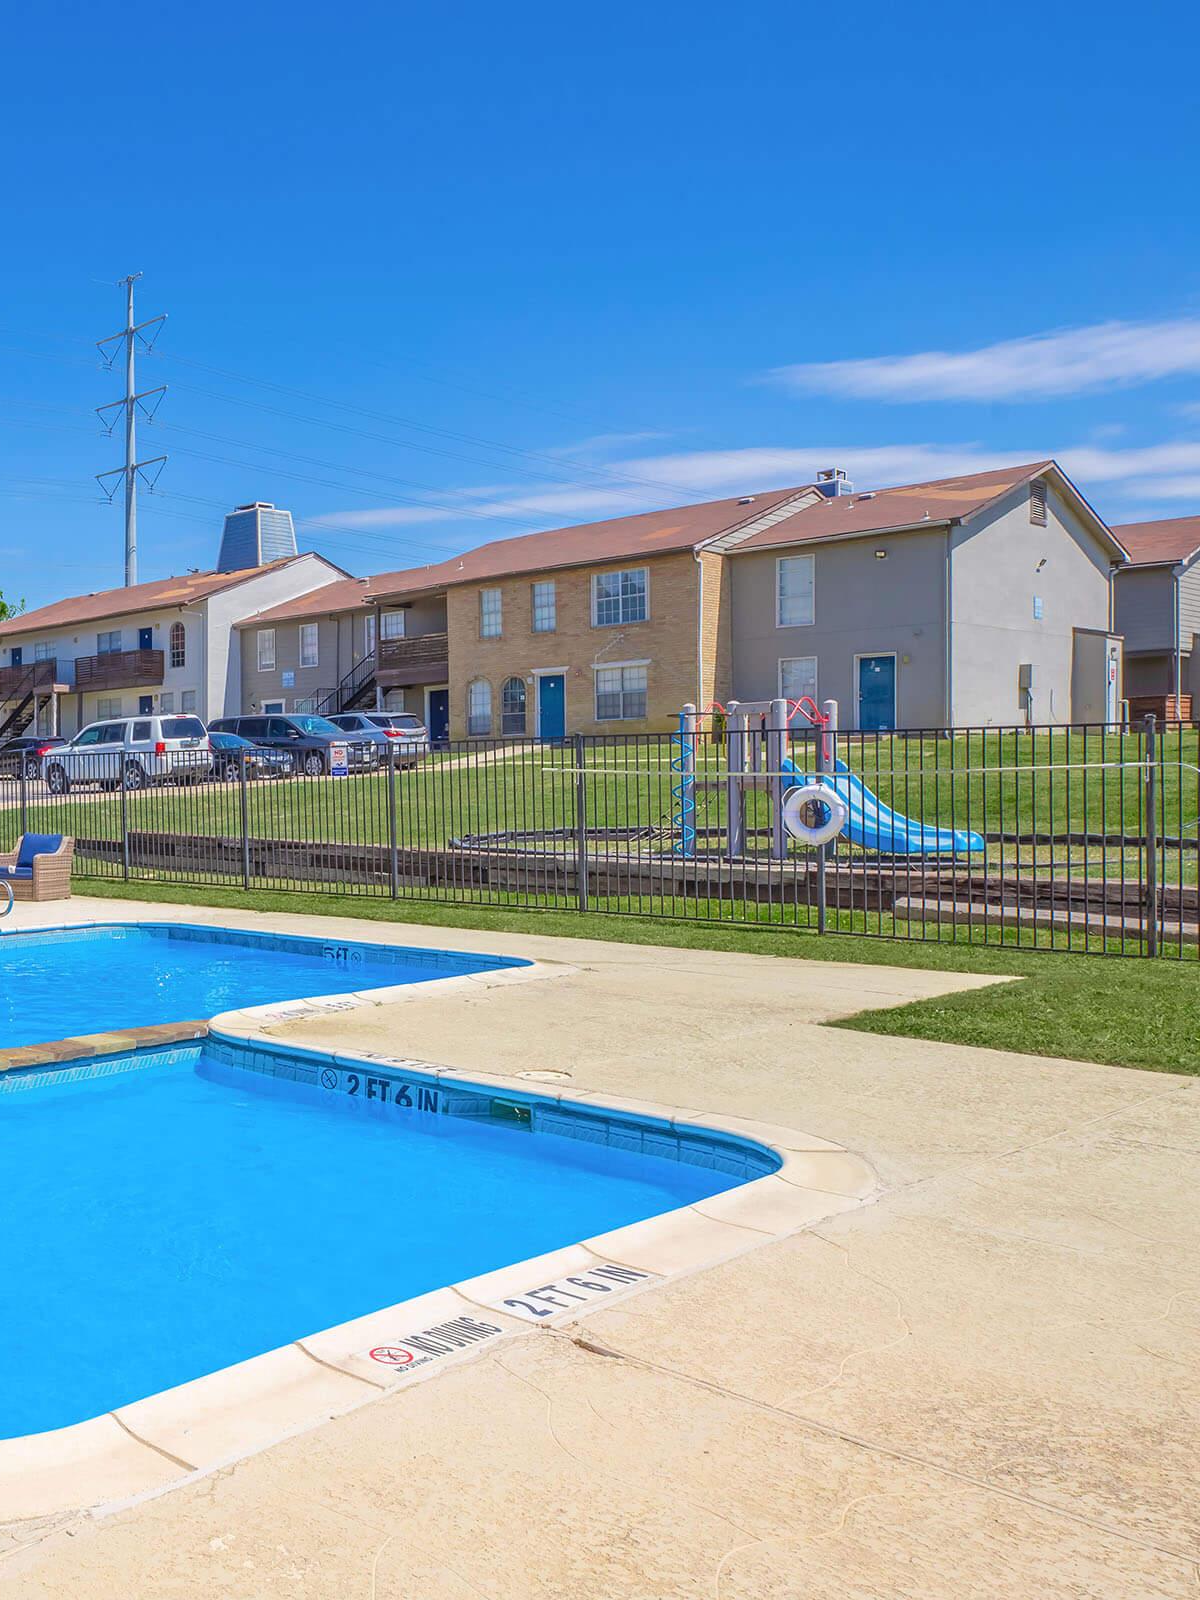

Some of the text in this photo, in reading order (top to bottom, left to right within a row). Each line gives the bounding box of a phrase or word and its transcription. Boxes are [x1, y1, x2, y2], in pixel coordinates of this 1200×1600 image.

[347, 1074, 439, 1113] 2 FT 6 IN
[504, 1264, 649, 1317] 2 FT 6 IN
[399, 1316, 502, 1357] NO DIVING
